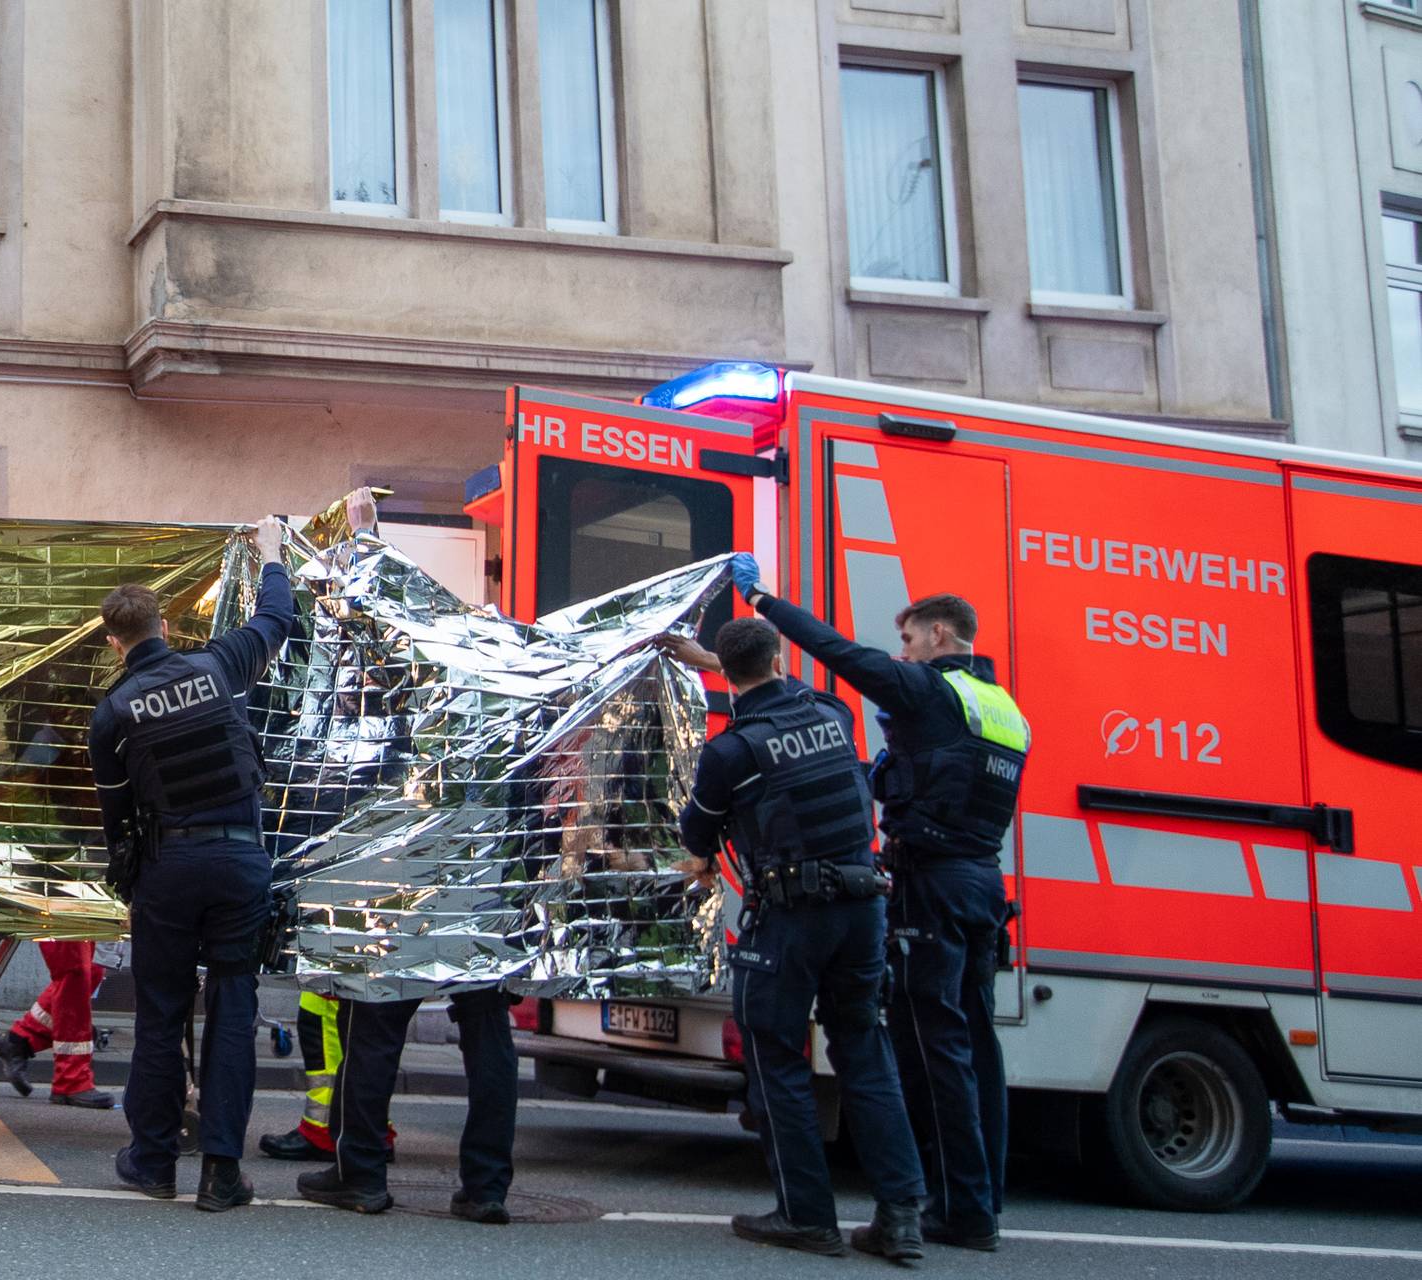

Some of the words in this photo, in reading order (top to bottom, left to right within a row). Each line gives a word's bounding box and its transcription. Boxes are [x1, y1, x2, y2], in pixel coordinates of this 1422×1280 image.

[518, 412, 566, 449] HR
[581, 422, 693, 469] ESSEN
[1018, 528, 1286, 596] FEUERWEHR
[1085, 606, 1227, 657] ESSEN
[129, 674, 220, 723] POLIZEI
[765, 720, 847, 765] POLIZEI
[1145, 717, 1222, 765] 112
[985, 754, 1019, 782] NRW
[643, 1010, 675, 1033] 1126
